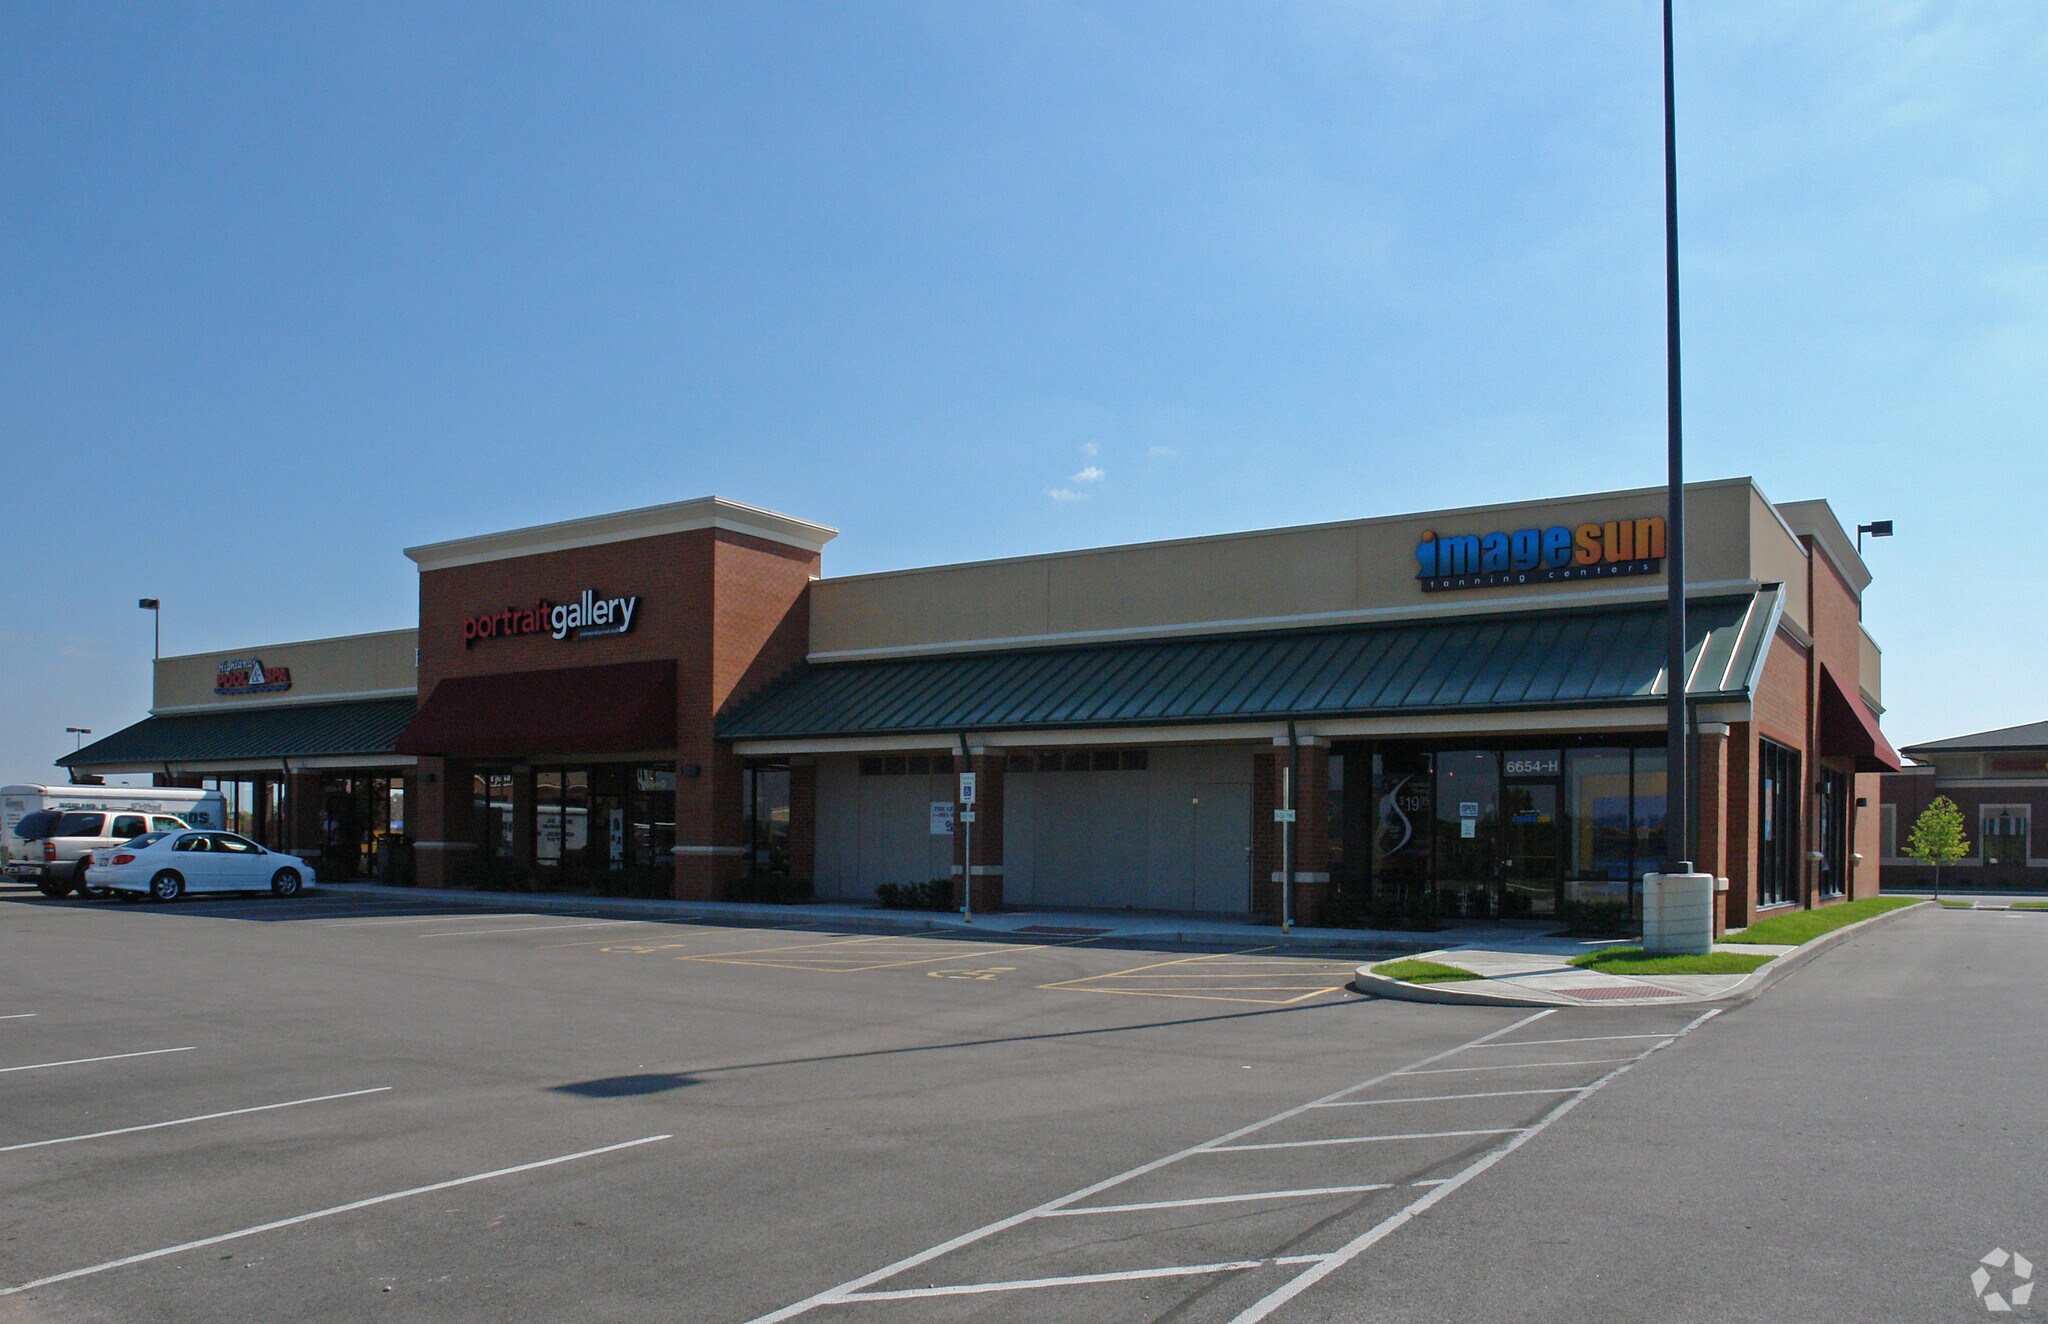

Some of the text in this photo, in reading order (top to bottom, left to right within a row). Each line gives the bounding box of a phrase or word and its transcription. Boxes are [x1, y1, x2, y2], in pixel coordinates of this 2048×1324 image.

[1415, 516, 1665, 579] imagesun
[1430, 563, 1649, 588] tanning centers
[216, 671, 248, 688] POOL
[264, 667, 286, 683] SPA
[1507, 760, 1558, 773] 6654-H
[1462, 804, 1477, 813] OPEN
